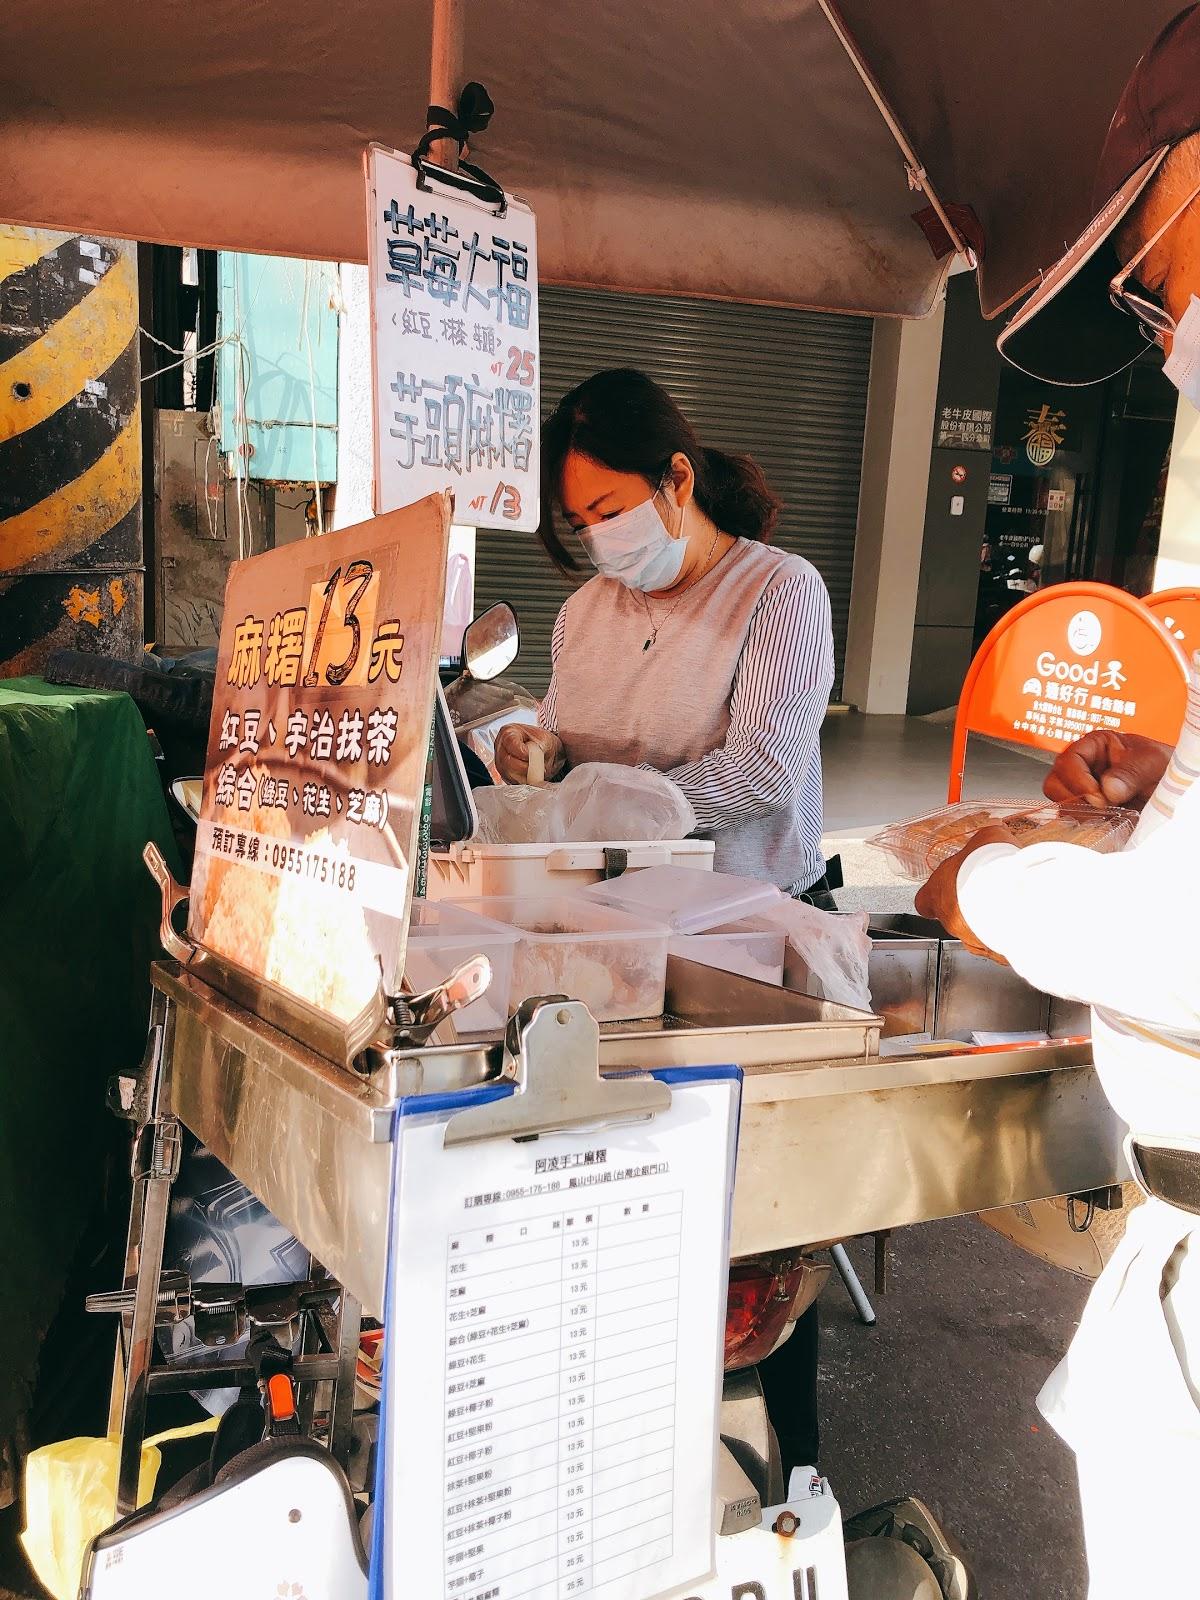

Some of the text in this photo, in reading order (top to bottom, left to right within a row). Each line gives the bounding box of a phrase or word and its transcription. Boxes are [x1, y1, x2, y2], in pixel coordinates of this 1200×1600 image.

[384, 199, 531, 330] 草莓大福
[506, 346, 535, 386] 25
[941, 420, 991, 434] 股份有限公司
[942, 407, 992, 421] 老牛皮國際
[490, 481, 521, 520] 13
[1036, 651, 1099, 686] Good
